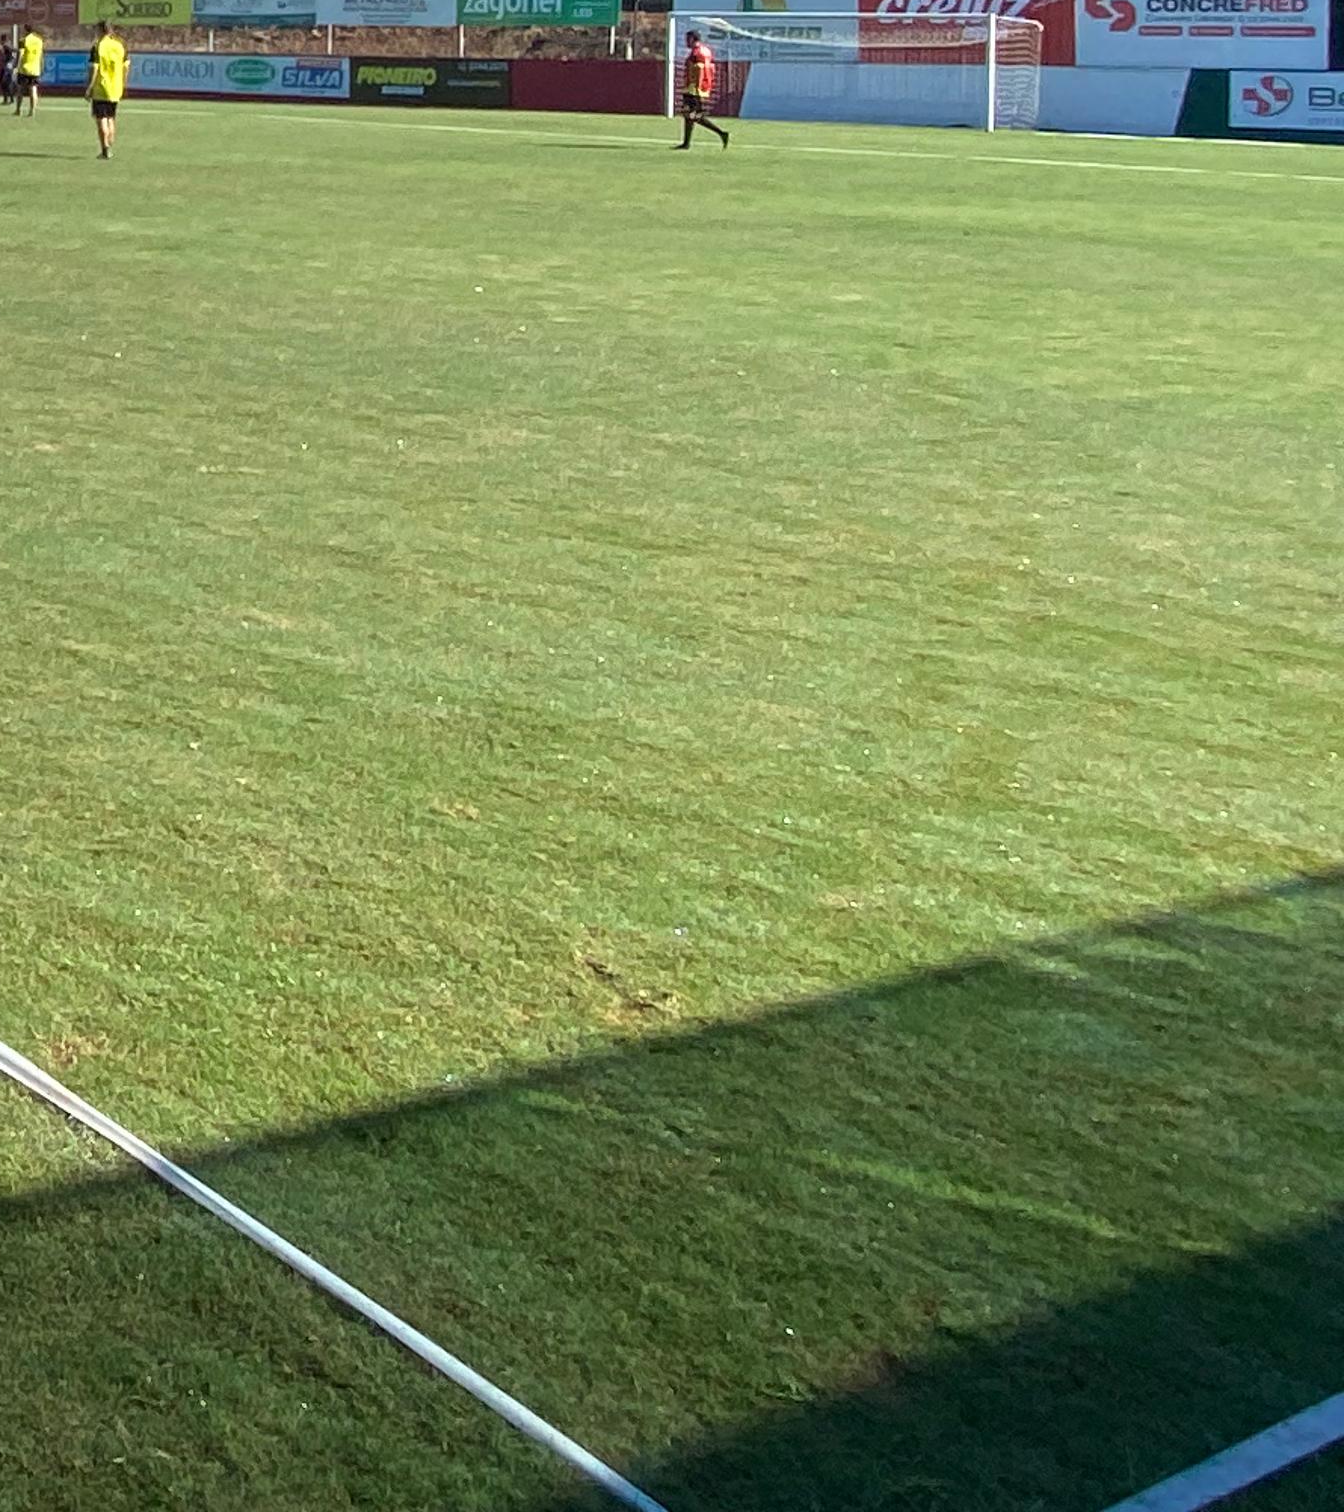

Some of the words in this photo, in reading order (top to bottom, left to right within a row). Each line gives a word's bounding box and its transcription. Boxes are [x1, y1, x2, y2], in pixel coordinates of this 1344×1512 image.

[141, 59, 213, 80] GIRARDI
[282, 67, 342, 88] SILVA
[1308, 87, 1344, 107] B
